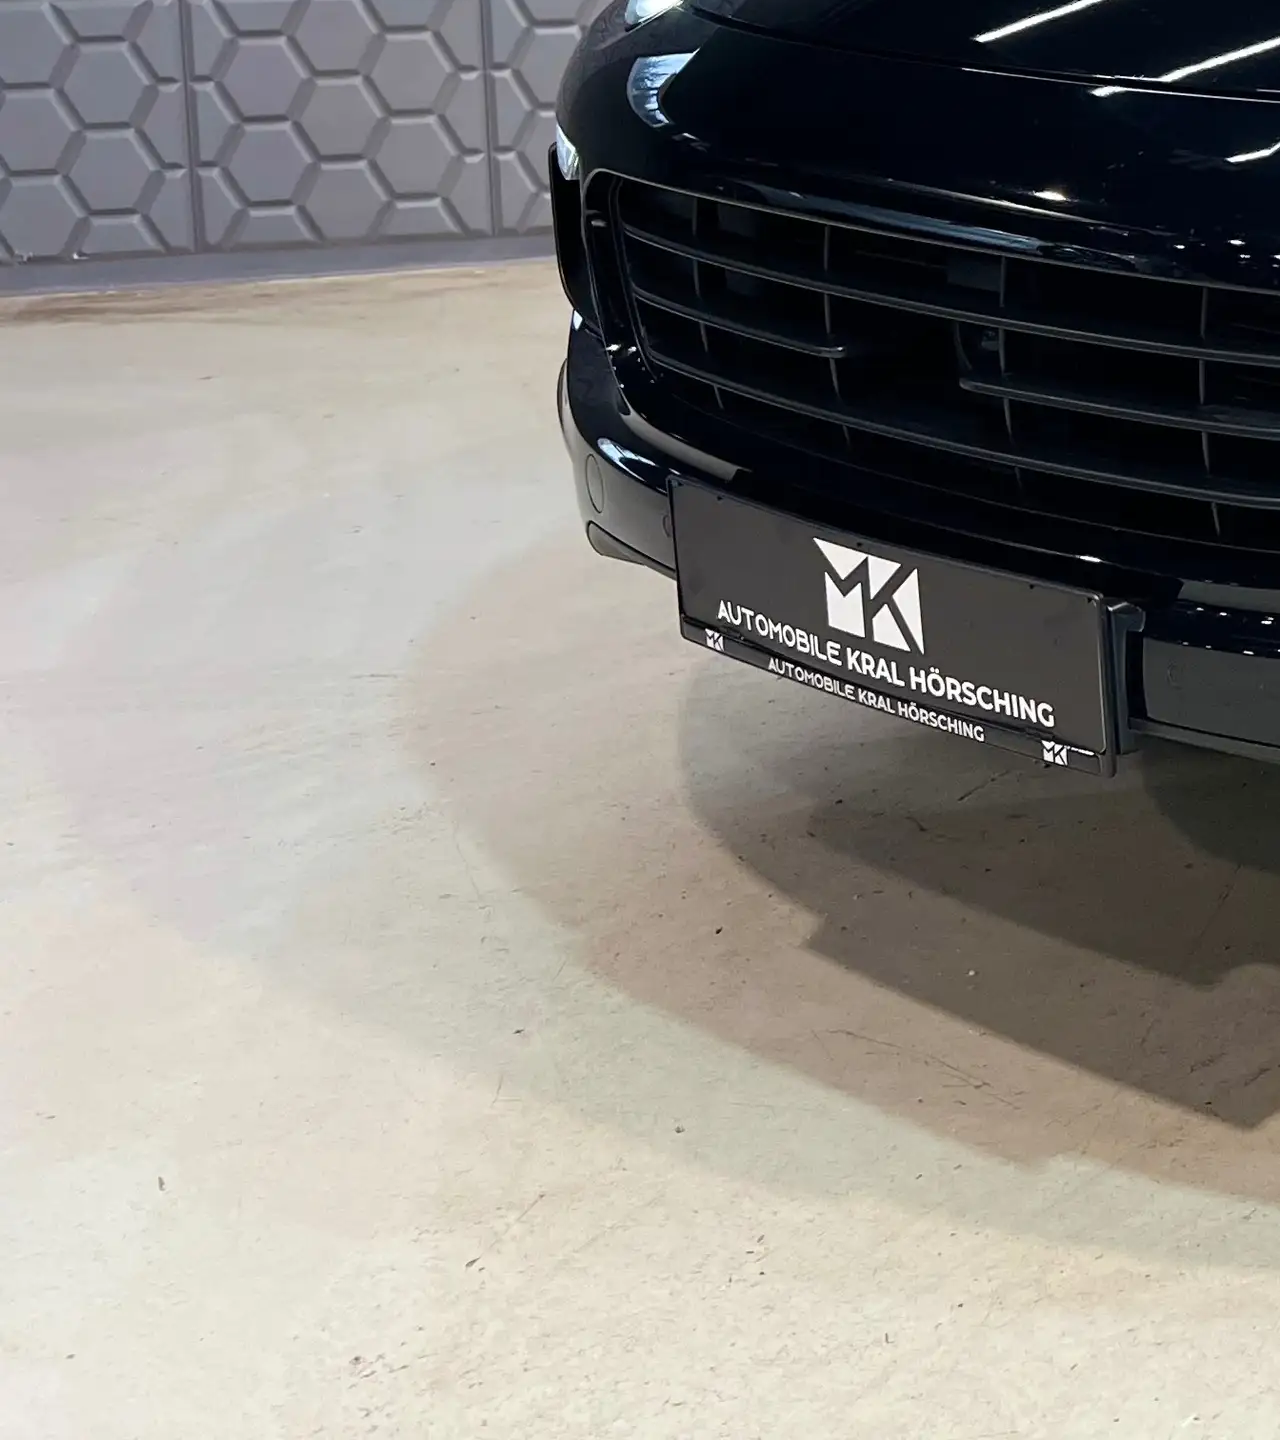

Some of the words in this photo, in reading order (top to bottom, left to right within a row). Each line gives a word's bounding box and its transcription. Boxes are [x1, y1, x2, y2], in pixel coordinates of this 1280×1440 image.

[813, 537, 925, 655] MK
[717, 599, 843, 666] AUTOMOBILE
[846, 647, 905, 688] KRAL
[909, 666, 1055, 728] HÖRSCHING
[768, 657, 855, 700] AUTOMOBILE
[858, 688, 895, 714] KRAL
[898, 702, 985, 743] HÖRSCHING
